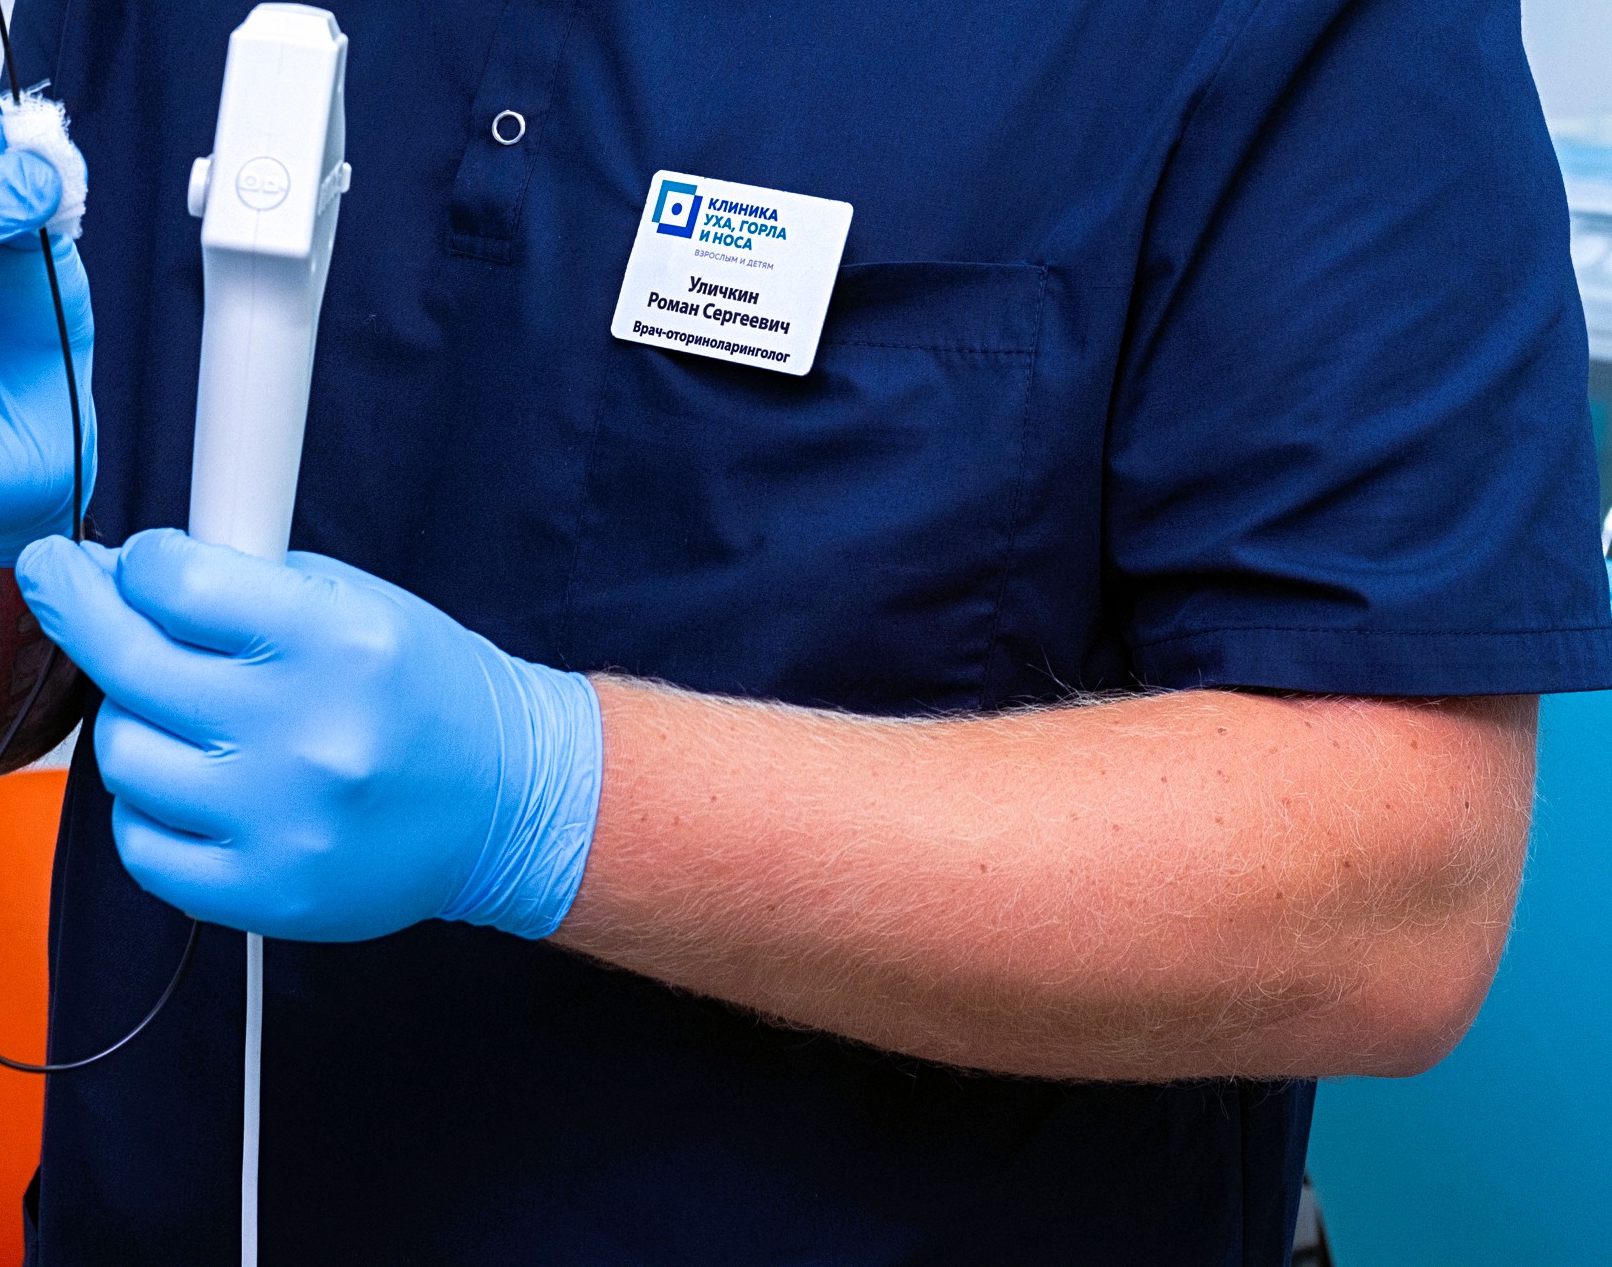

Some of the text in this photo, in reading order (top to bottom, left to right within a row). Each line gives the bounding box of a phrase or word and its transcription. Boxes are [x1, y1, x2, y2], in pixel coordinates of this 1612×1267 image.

[707, 198, 779, 222] КЛИНИКА
[699, 230, 753, 251] И НОСА
[703, 214, 787, 241] УХА, ГОРЛА
[694, 249, 774, 271] ВЗРОСЛЫМ И ДЕТЯМ
[687, 275, 760, 305] Уличкин
[647, 291, 791, 335] Роман Сергеевич
[632, 320, 791, 364] Врач-оториноларинголог
